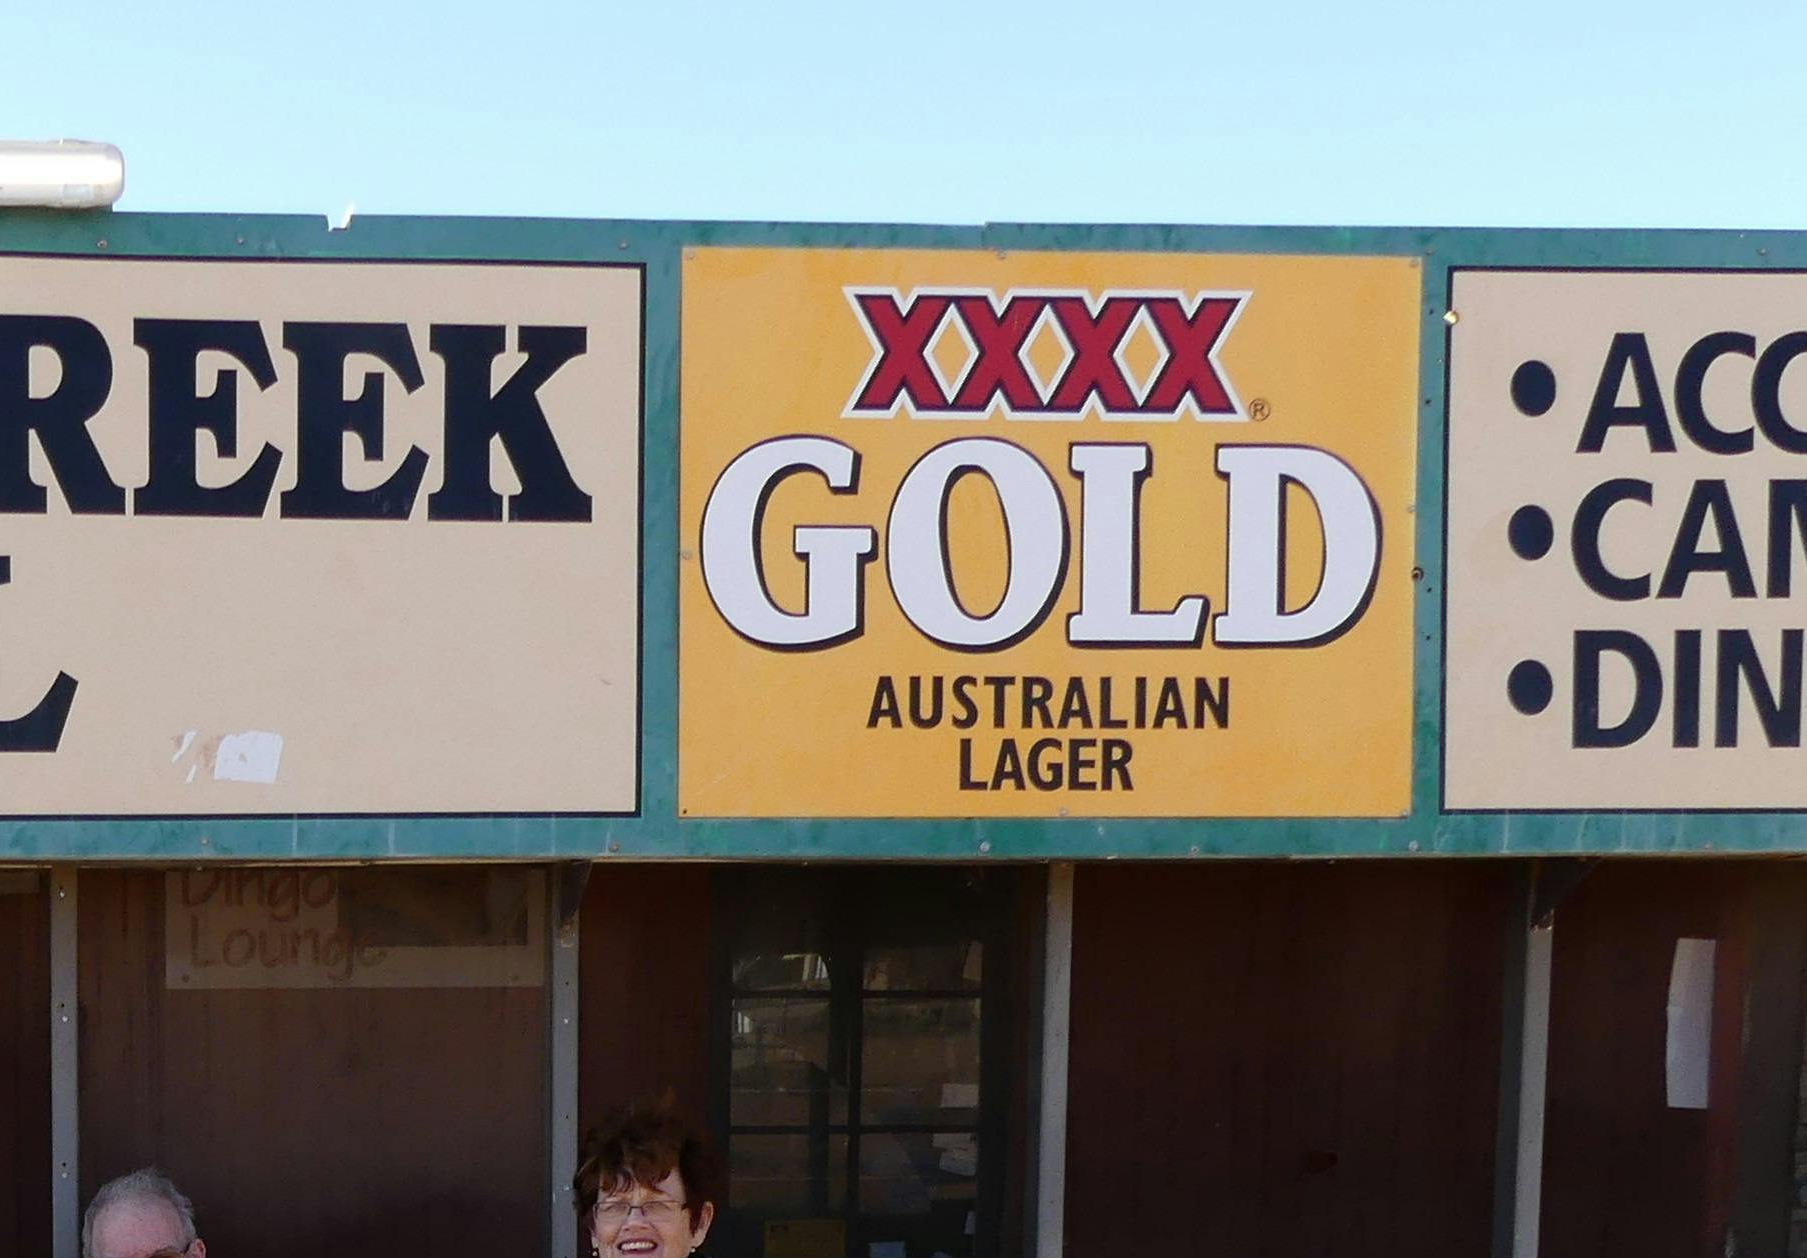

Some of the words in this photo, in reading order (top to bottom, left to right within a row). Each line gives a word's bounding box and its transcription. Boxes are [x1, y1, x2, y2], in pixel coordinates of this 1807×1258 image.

[847, 291, 1249, 418] XXXX
[1576, 330, 1807, 455] ACC
[698, 434, 1384, 650] GOLD
[866, 675, 1230, 730] AUSTRALIAN
[1572, 628, 1804, 749] DIN
[958, 737, 1134, 792] LAGER
[191, 914, 387, 981] Lounge
